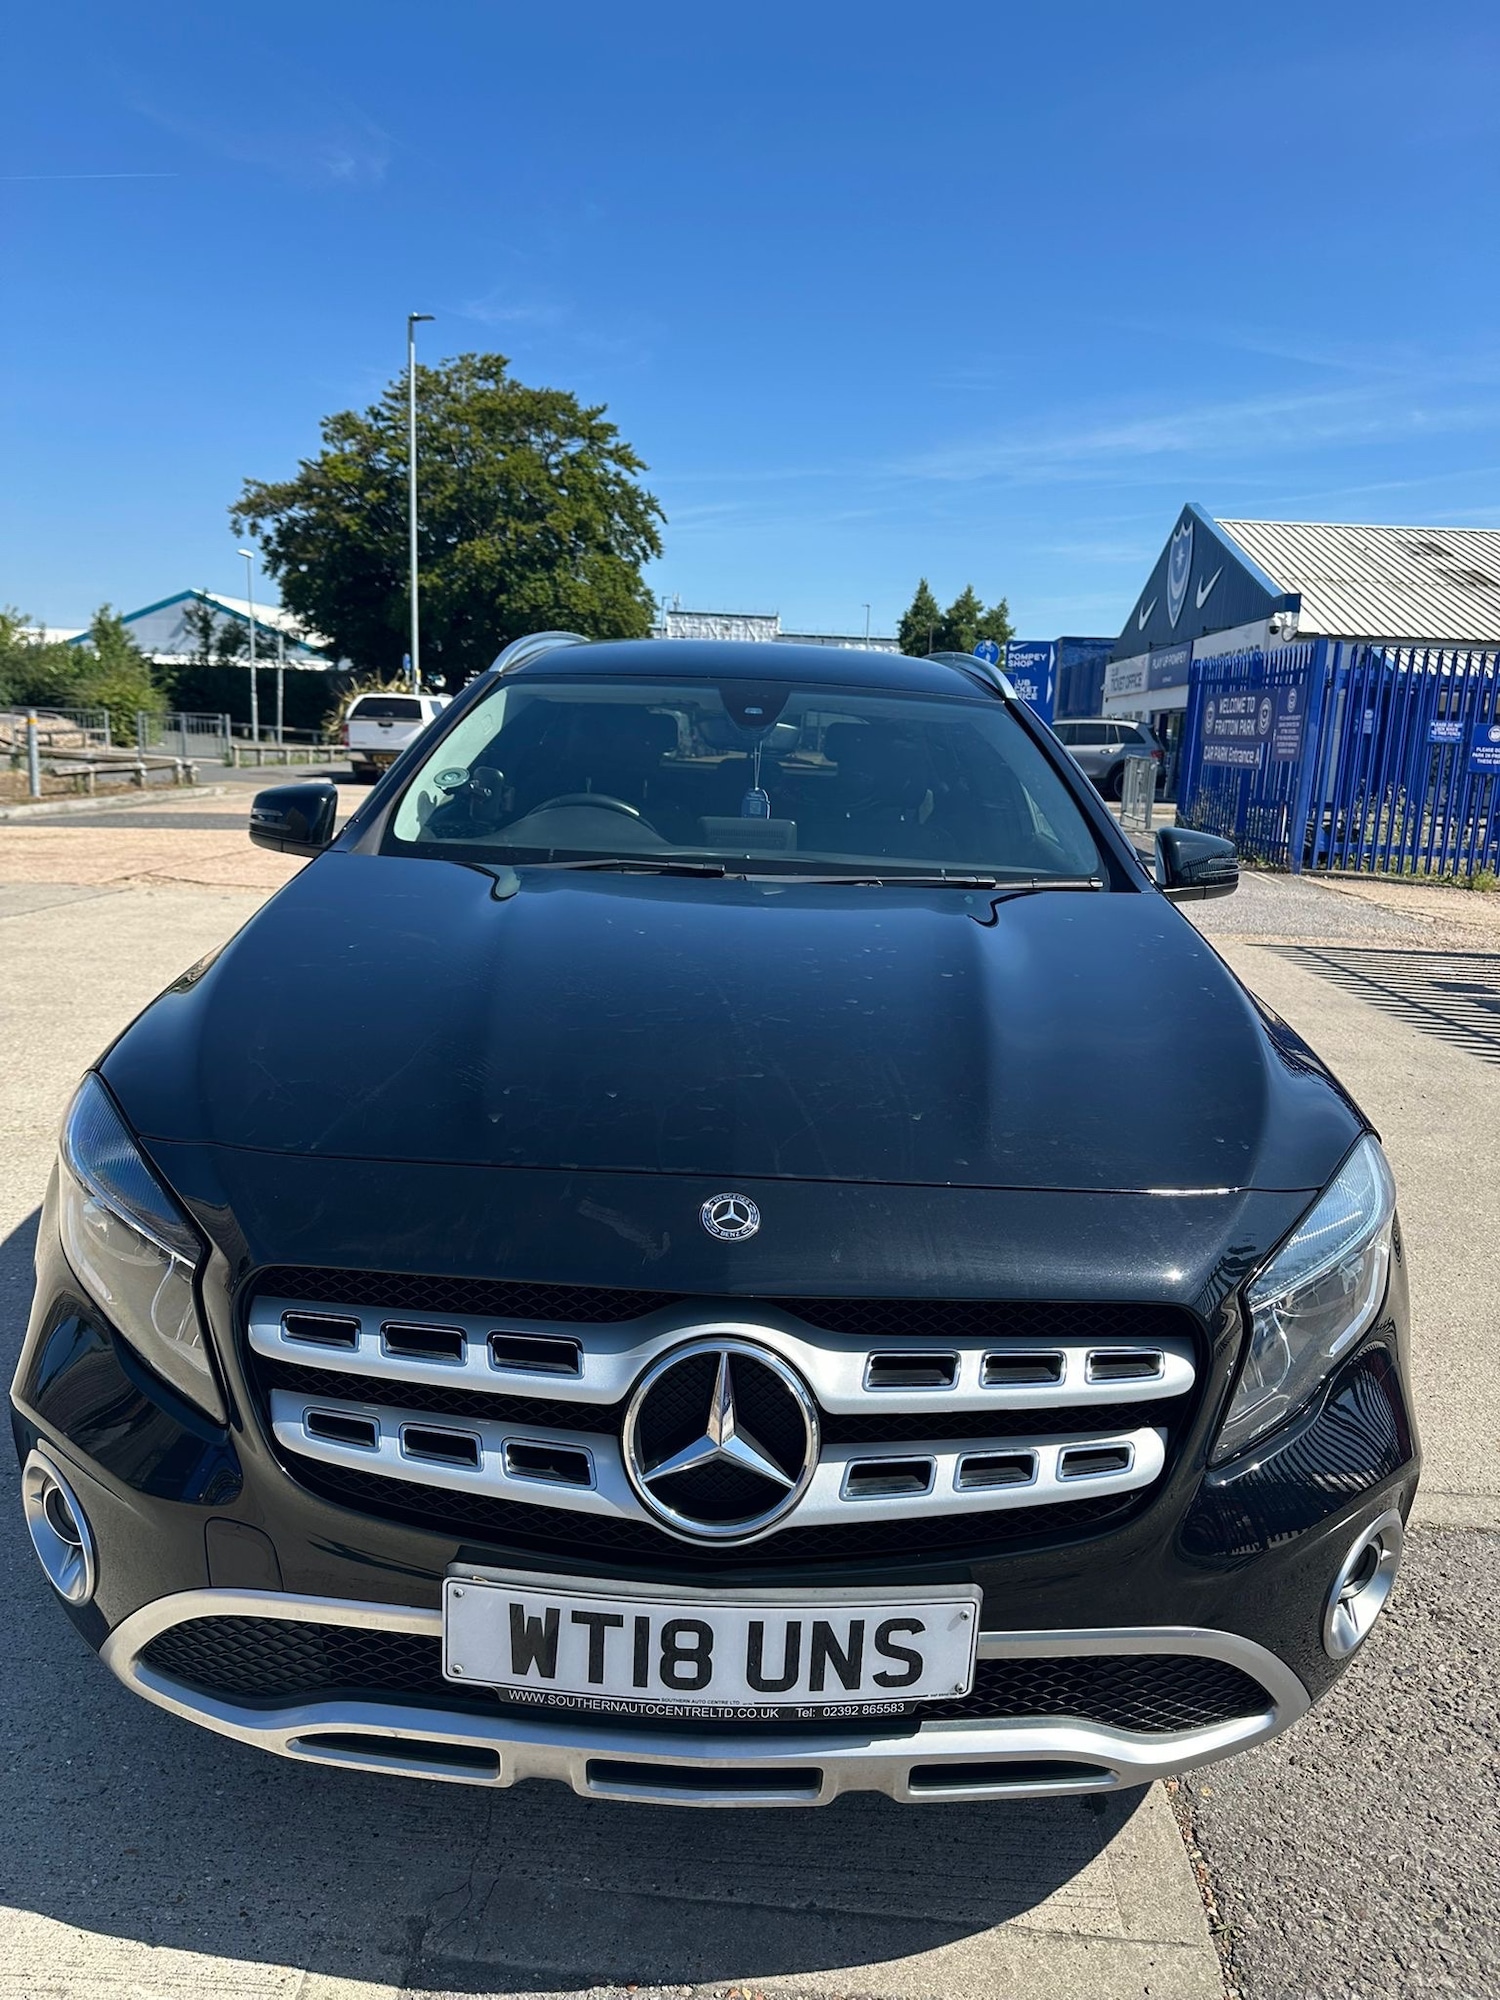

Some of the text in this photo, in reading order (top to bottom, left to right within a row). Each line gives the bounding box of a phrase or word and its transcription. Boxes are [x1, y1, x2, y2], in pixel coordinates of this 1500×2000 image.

[1008, 653, 1047, 661] POMPEY
[1219, 696, 1256, 714] WELCOME TO
[1214, 719, 1256, 735] FRATTON PARK
[1203, 745, 1214, 760] CAR
[1213, 745, 1229, 761] PARK
[1228, 746, 1255, 763] Entrance
[509, 1602, 927, 1693] WT18 UNS
[508, 1689, 905, 1719] WWW.SOUTHERNAUTOCENTRELTD.CO.UK Tel: 02392 865583
